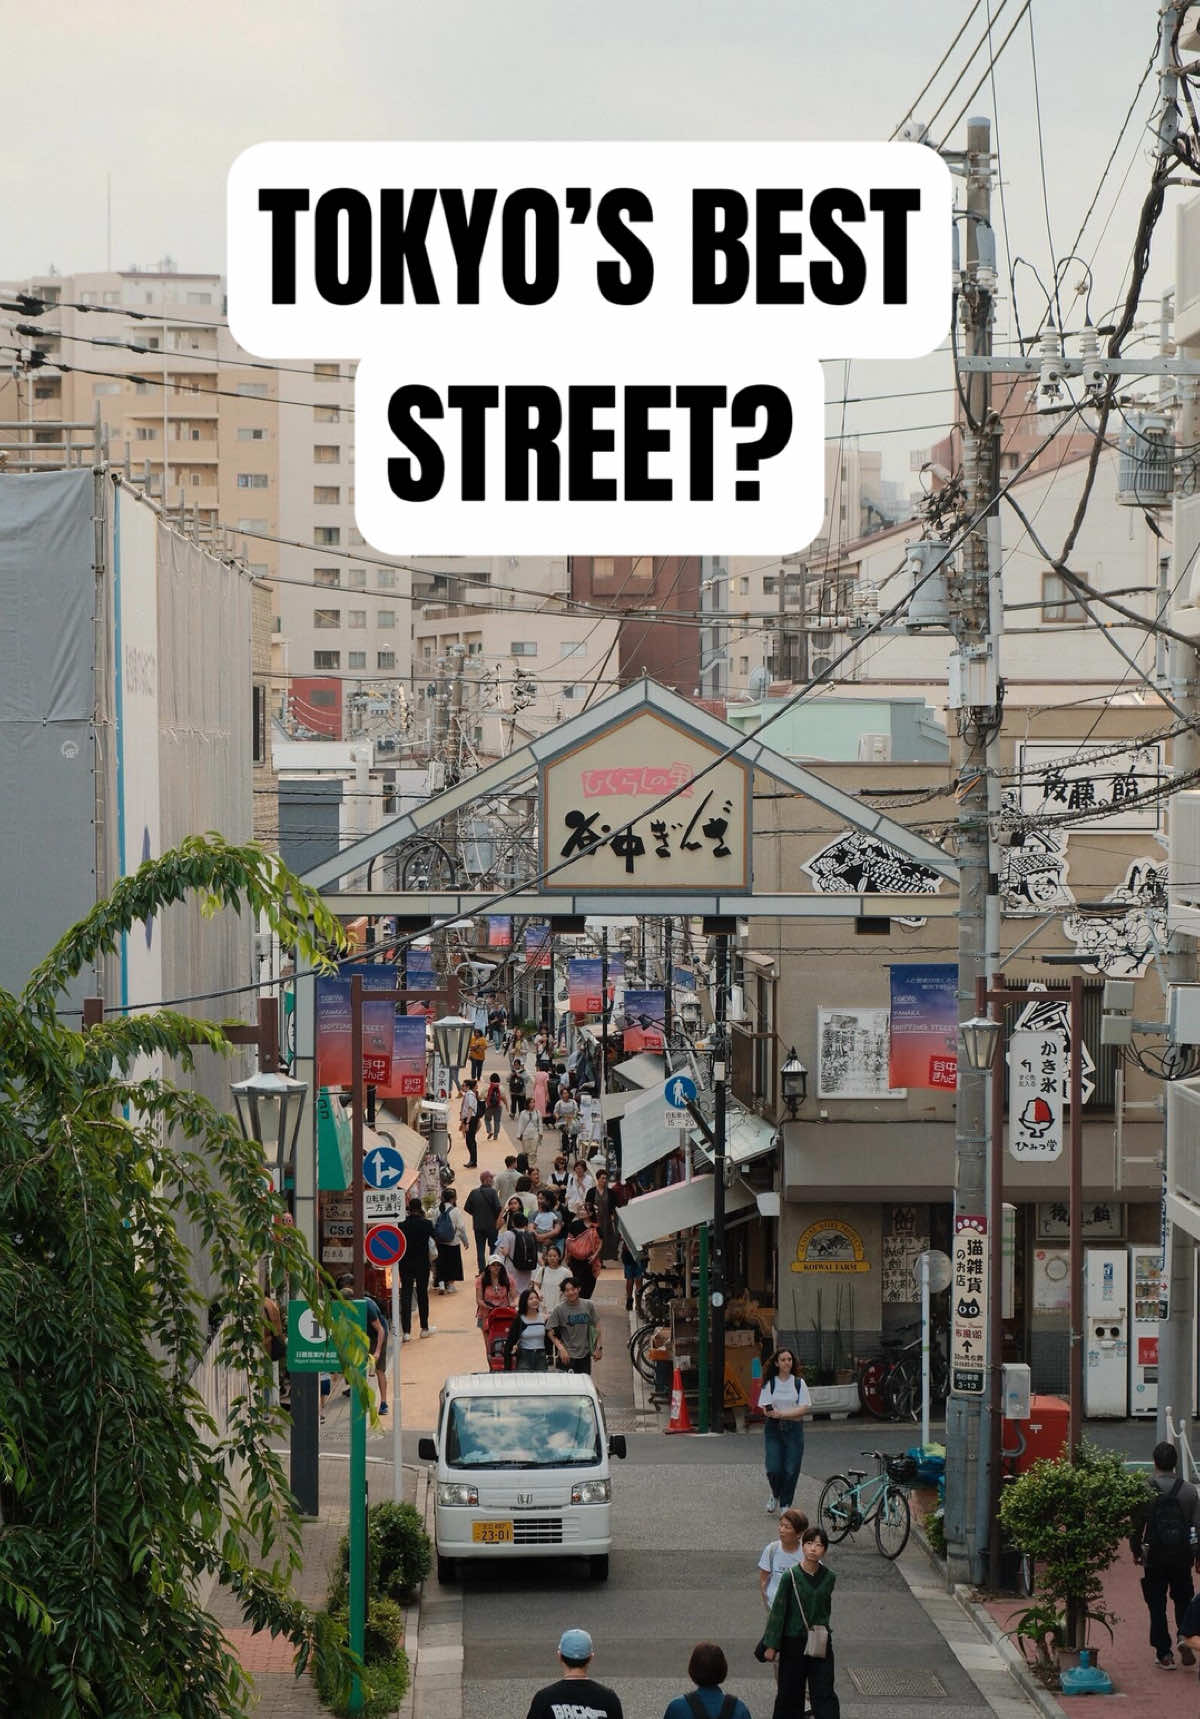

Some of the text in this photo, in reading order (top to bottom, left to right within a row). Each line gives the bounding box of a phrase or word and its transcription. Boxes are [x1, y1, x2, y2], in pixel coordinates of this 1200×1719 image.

[1040, 1040, 1058, 1094] かき氷
[1016, 1139, 1058, 1152] ひみつ堂
[366, 1203, 401, 1212] 一方通行
[956, 1249, 966, 1287] のお店
[966, 1239, 984, 1294] 猫雑貨
